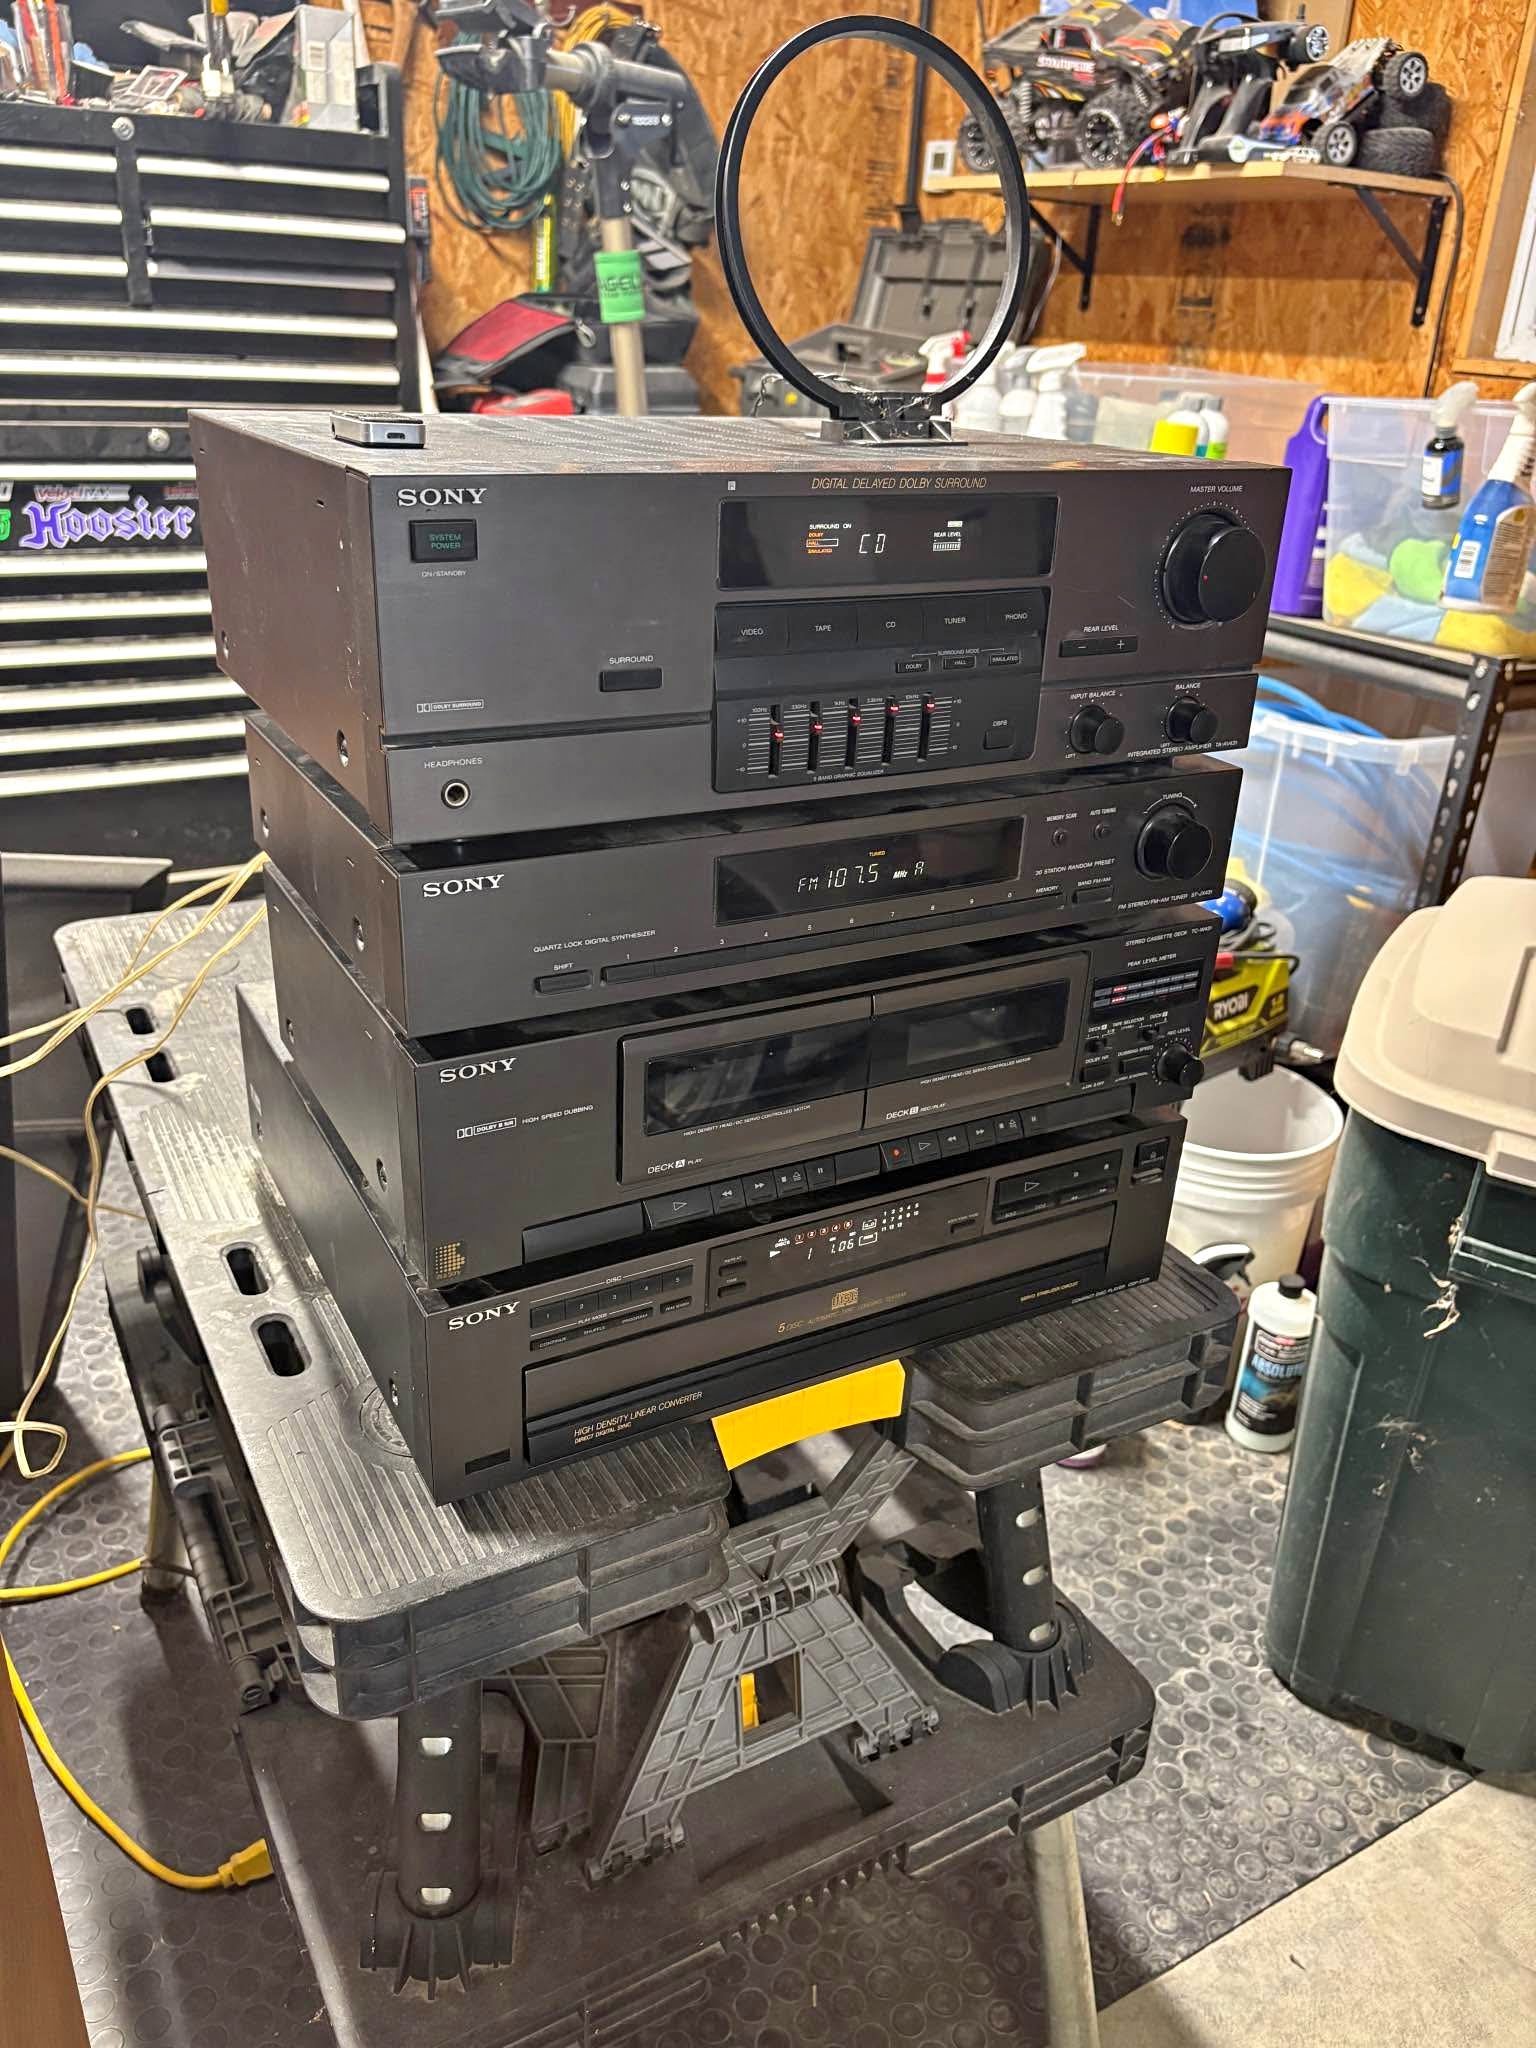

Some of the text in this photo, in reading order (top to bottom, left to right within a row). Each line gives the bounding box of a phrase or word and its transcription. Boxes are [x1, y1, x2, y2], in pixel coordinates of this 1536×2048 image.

[812, 477, 987, 490] DIGITAL DELAYED DOLBY SURROUND
[398, 488, 487, 506] SONY
[19, 496, 196, 549] Hoosier
[429, 533, 462, 542] SYSTEM
[430, 542, 462, 550] POWER
[858, 533, 886, 554] CD
[421, 570, 467, 578] ON/STANDBY
[944, 616, 966, 625] TUNER
[1005, 612, 1028, 621] PHONO
[815, 624, 832, 633] TAPE
[886, 620, 896, 629] CD
[1101, 624, 1119, 632] LEVEL
[741, 628, 764, 637] VIDEO
[937, 648, 965, 656] SURROUND
[609, 655, 654, 665] SURROUND
[1175, 682, 1201, 690] BALANCE
[1070, 690, 1116, 700] INPUT BALANCE
[452, 701, 482, 709] SURROUND
[1128, 742, 1212, 758] INTEGRATED STEREO AMPLIFIER
[424, 757, 483, 769] HEADPHONES
[1162, 792, 1183, 800] TUNING
[1046, 812, 1077, 822] MEMORY SCAN
[1044, 866, 1068, 875] STATION
[1068, 862, 1093, 871] RANDOM
[1094, 858, 1115, 867] PRESET
[798, 876, 818, 894] FM
[828, 863, 878, 889] 107.5
[892, 870, 908, 880] MHz
[422, 874, 504, 898] SONY
[1036, 885, 1058, 894] MEMORY
[1170, 892, 1188, 902] TUNER
[533, 930, 656, 952] QUARTZ LOCK DIGITAL SYNTHESIZER
[1125, 938, 1146, 947] STEREO
[1146, 933, 1173, 943] CASSETTE
[1127, 953, 1177, 968] PEAK LEVEL METER
[554, 962, 574, 971] SHIFT
[1213, 992, 1248, 1021] RYOBI
[440, 1057, 516, 1084] SONY
[522, 1104, 594, 1125] HIGH SPEED DUBBING
[761, 1108, 792, 1120] CONTROLLED
[886, 1109, 910, 1120] DECK
[476, 1123, 497, 1133] DOLBY
[647, 1161, 674, 1175] DECK
[675, 1158, 686, 1168] A
[606, 1274, 622, 1284] DISC
[448, 1301, 521, 1331] SONY
[778, 1320, 804, 1333] 5 DISC
[1251, 1354, 1306, 1378] ABSOLUT
[574, 1391, 703, 1438] HIGH DENSITY LINEAR CONVERTER
[574, 1434, 594, 1444] DIRECT
[596, 1428, 616, 1438] DIGITAL
